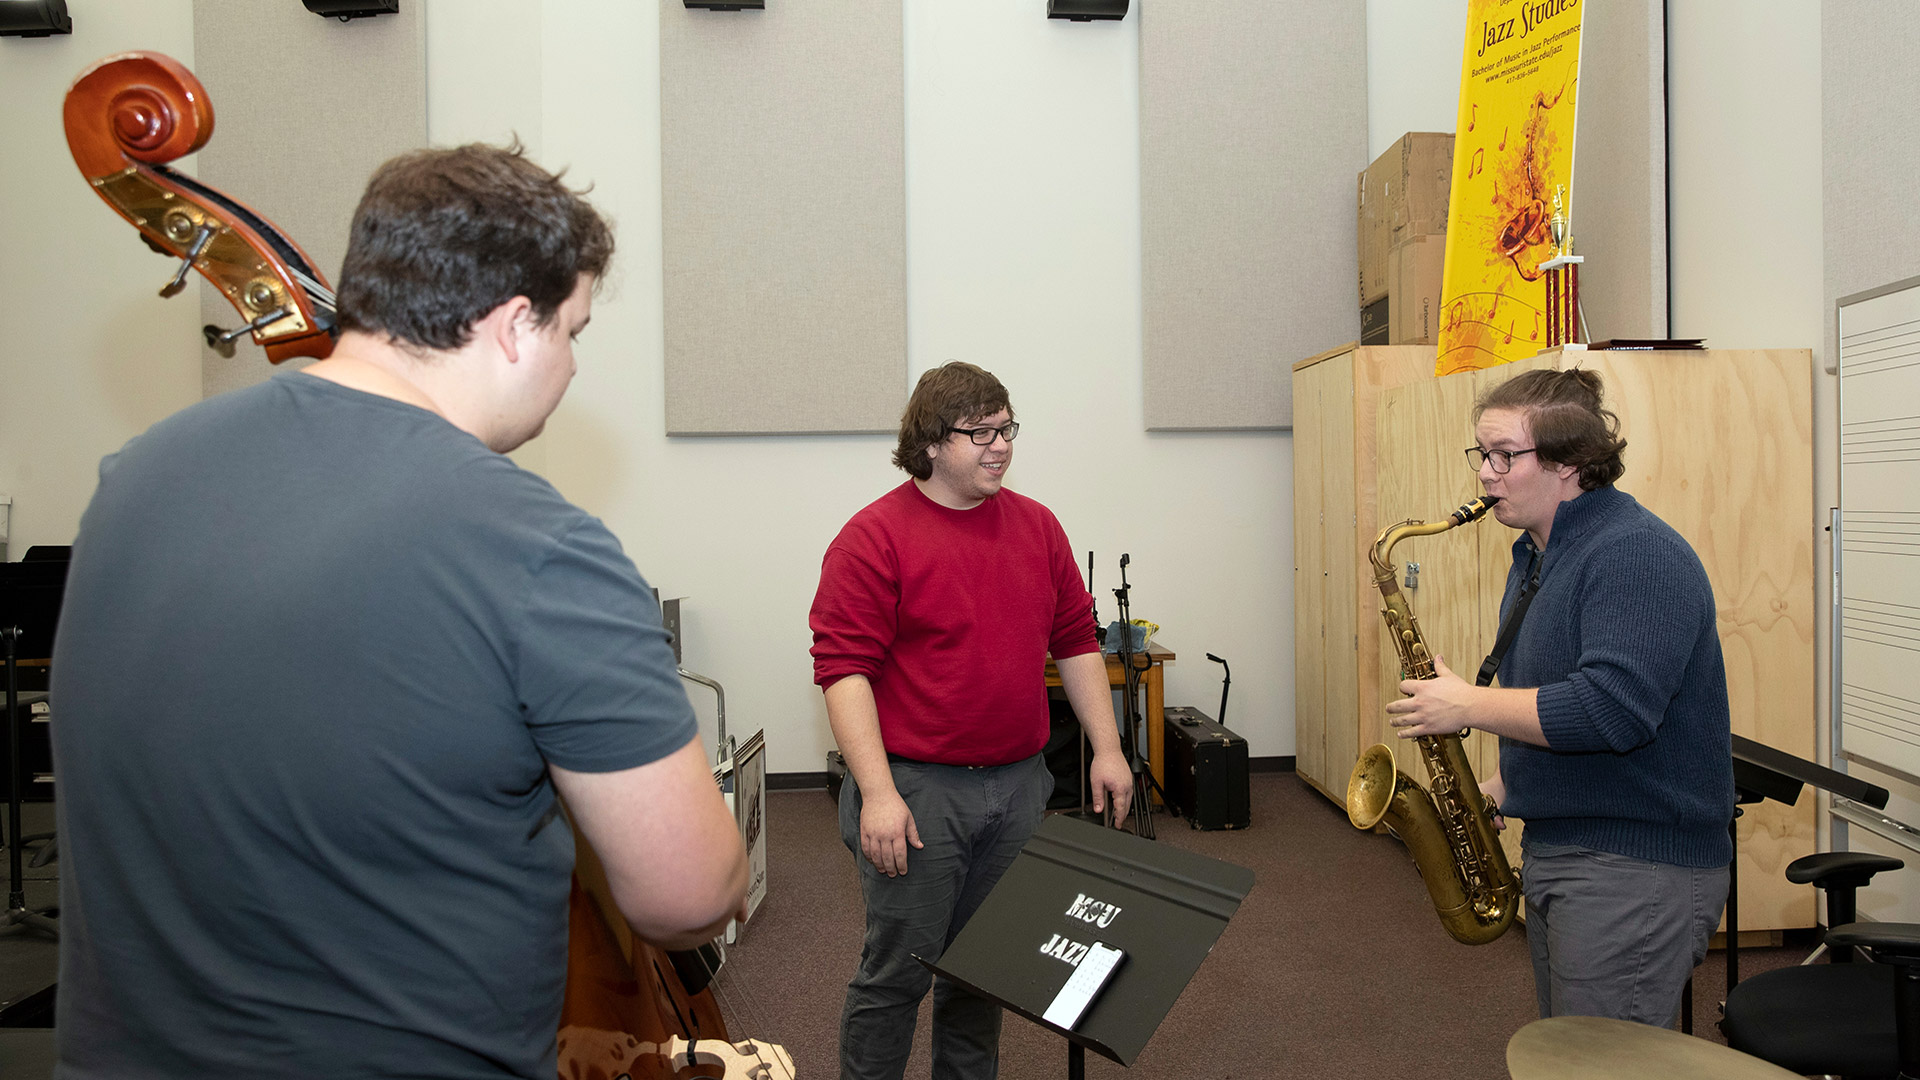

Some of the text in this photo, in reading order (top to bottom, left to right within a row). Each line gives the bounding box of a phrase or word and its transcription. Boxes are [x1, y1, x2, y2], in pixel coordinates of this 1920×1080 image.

[1478, 0, 1578, 57] Jazz Studies
[1471, 24, 1581, 78] Bachelor of Music in Jazz Performance
[1485, 44, 1563, 84] www.missouristate.edu/jazz
[1065, 893, 1122, 929] MSU
[1040, 933, 1089, 967] JAZZ
